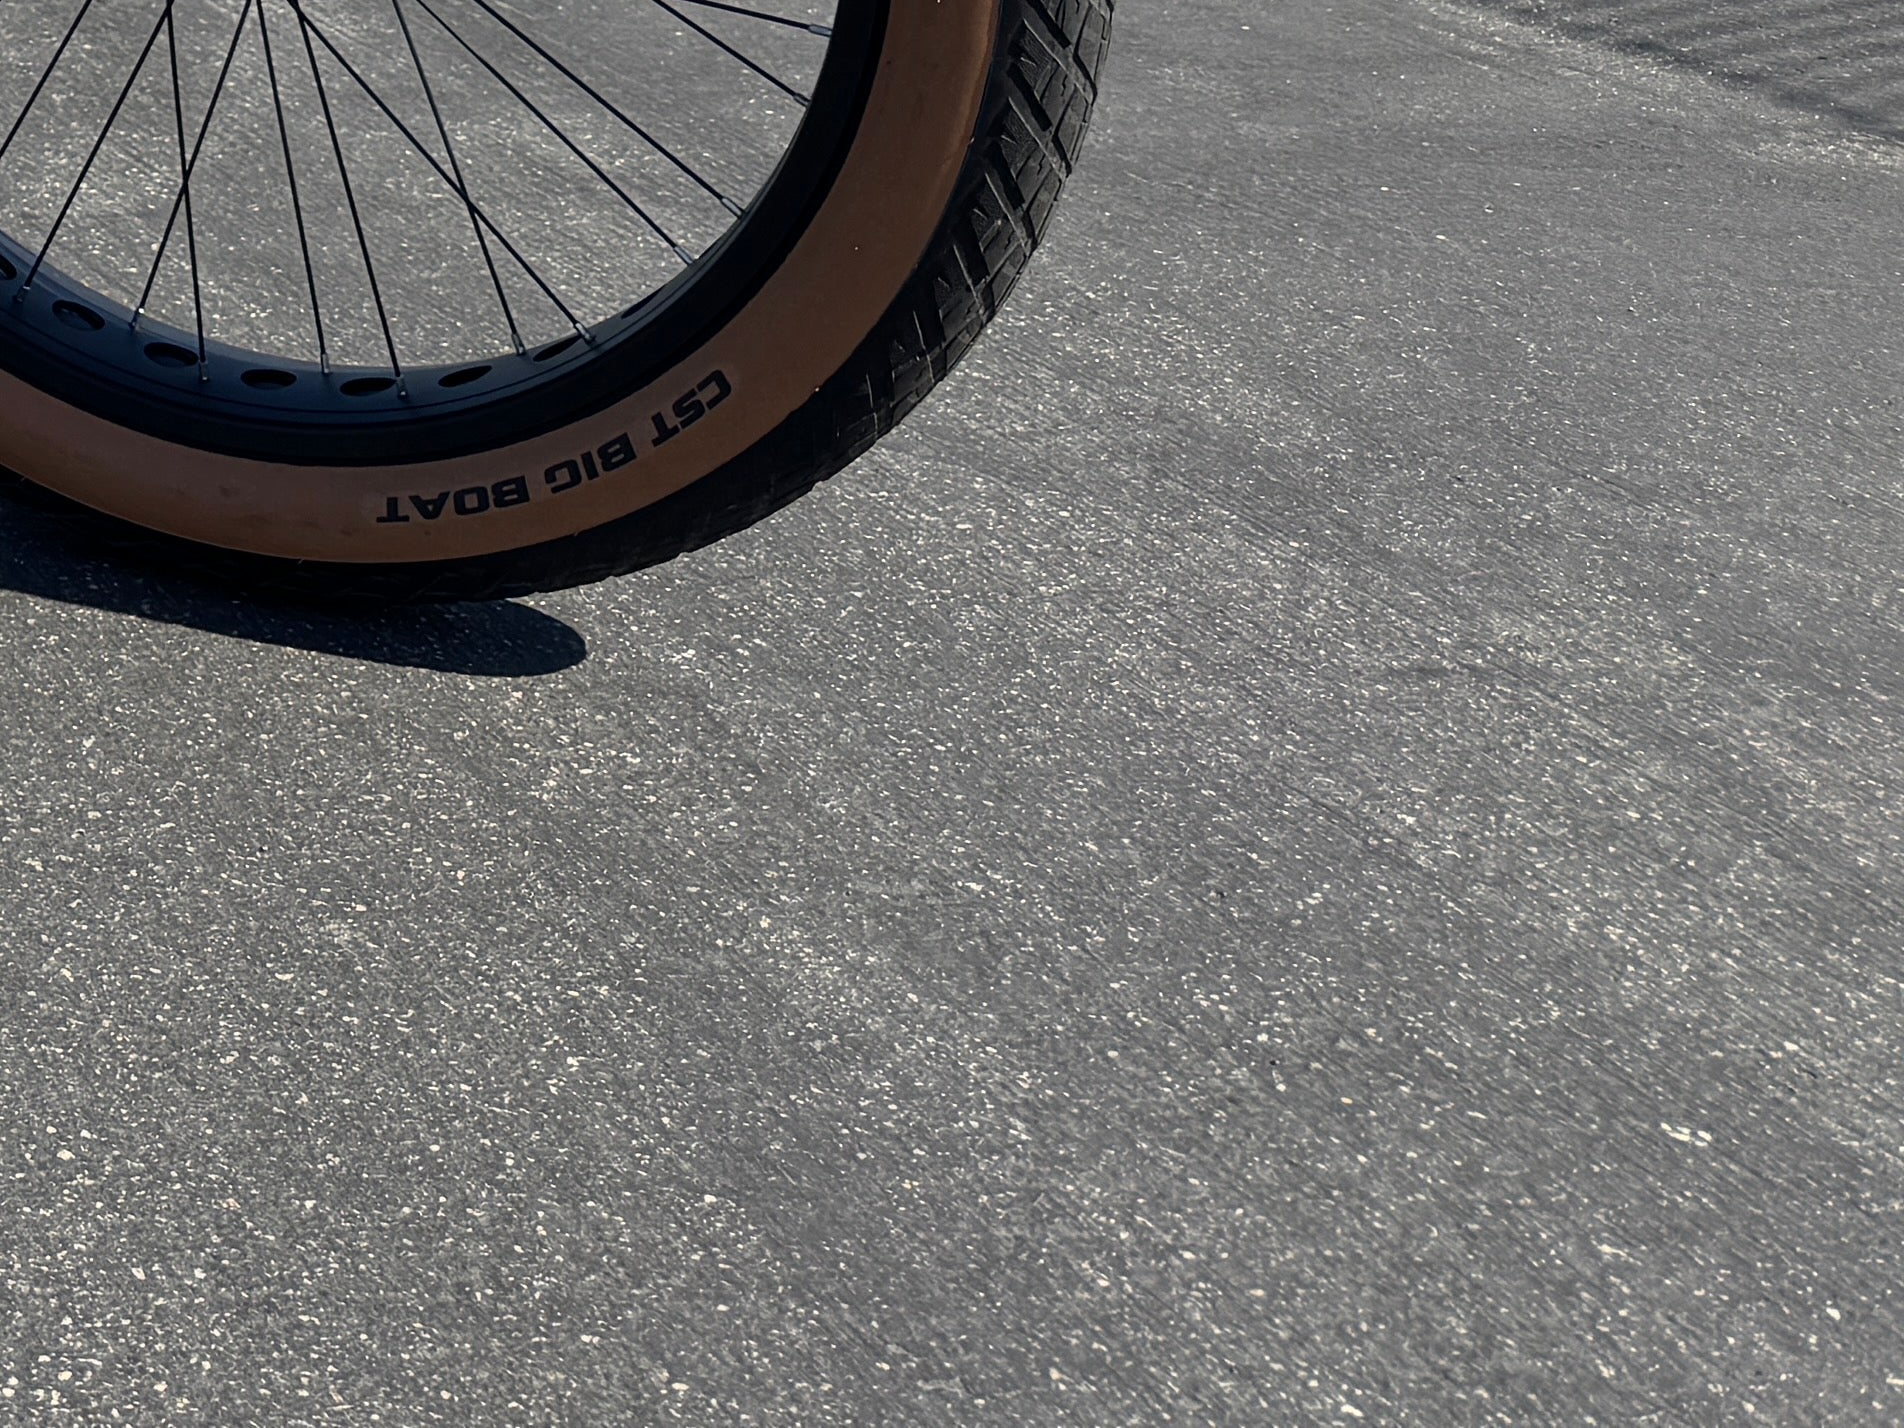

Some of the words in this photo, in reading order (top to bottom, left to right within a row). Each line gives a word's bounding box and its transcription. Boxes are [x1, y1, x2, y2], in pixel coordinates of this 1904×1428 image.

[651, 369, 732, 447] CST
[544, 432, 637, 494] BIG
[376, 475, 531, 523] BOAT
